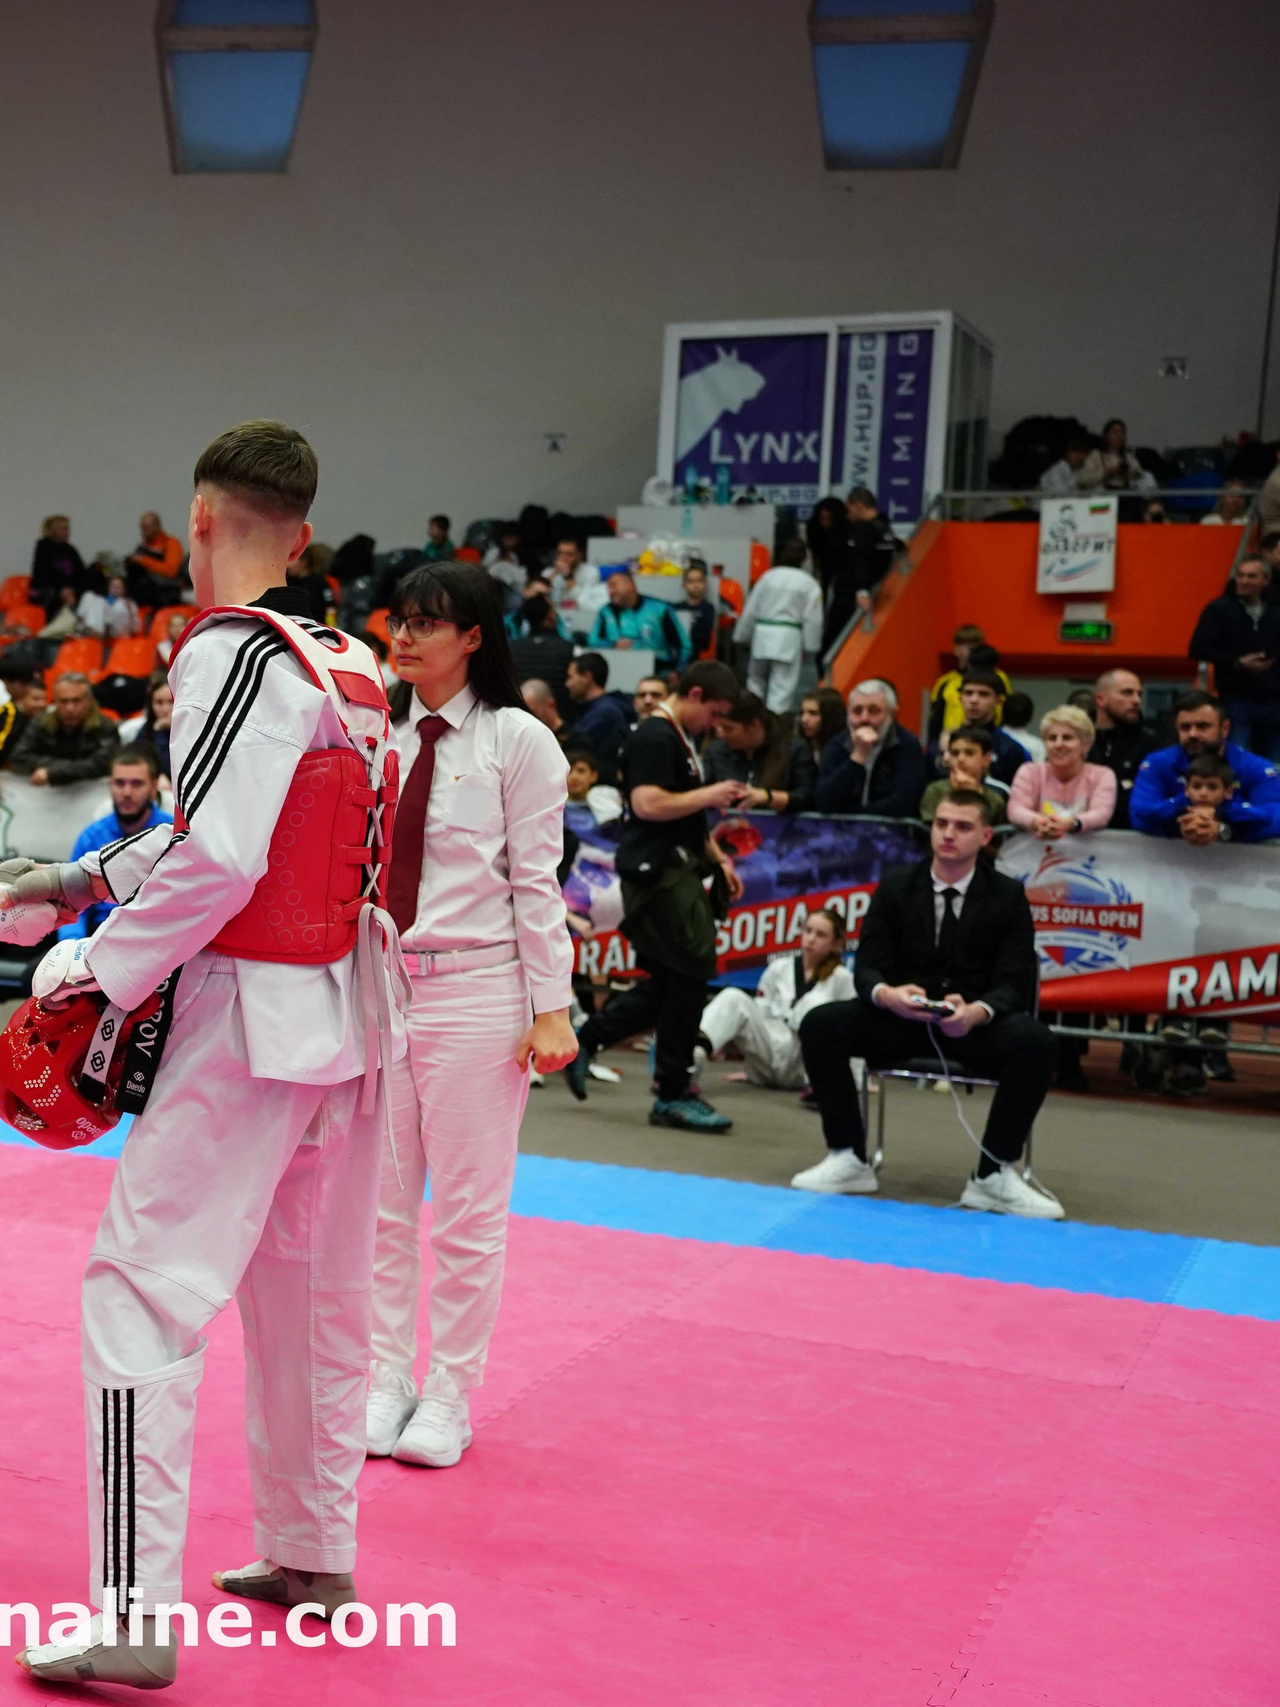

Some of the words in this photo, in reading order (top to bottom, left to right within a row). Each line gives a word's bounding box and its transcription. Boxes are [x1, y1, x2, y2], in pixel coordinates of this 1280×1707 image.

[888, 332, 919, 520] TIMING
[710, 427, 818, 464] LYNX
[716, 902, 807, 955] SOFIA
[824, 891, 872, 933] OP
[1052, 907, 1096, 926] SOFIA
[1099, 910, 1139, 929] OPEN
[126, 1080, 146, 1094] Daedo
